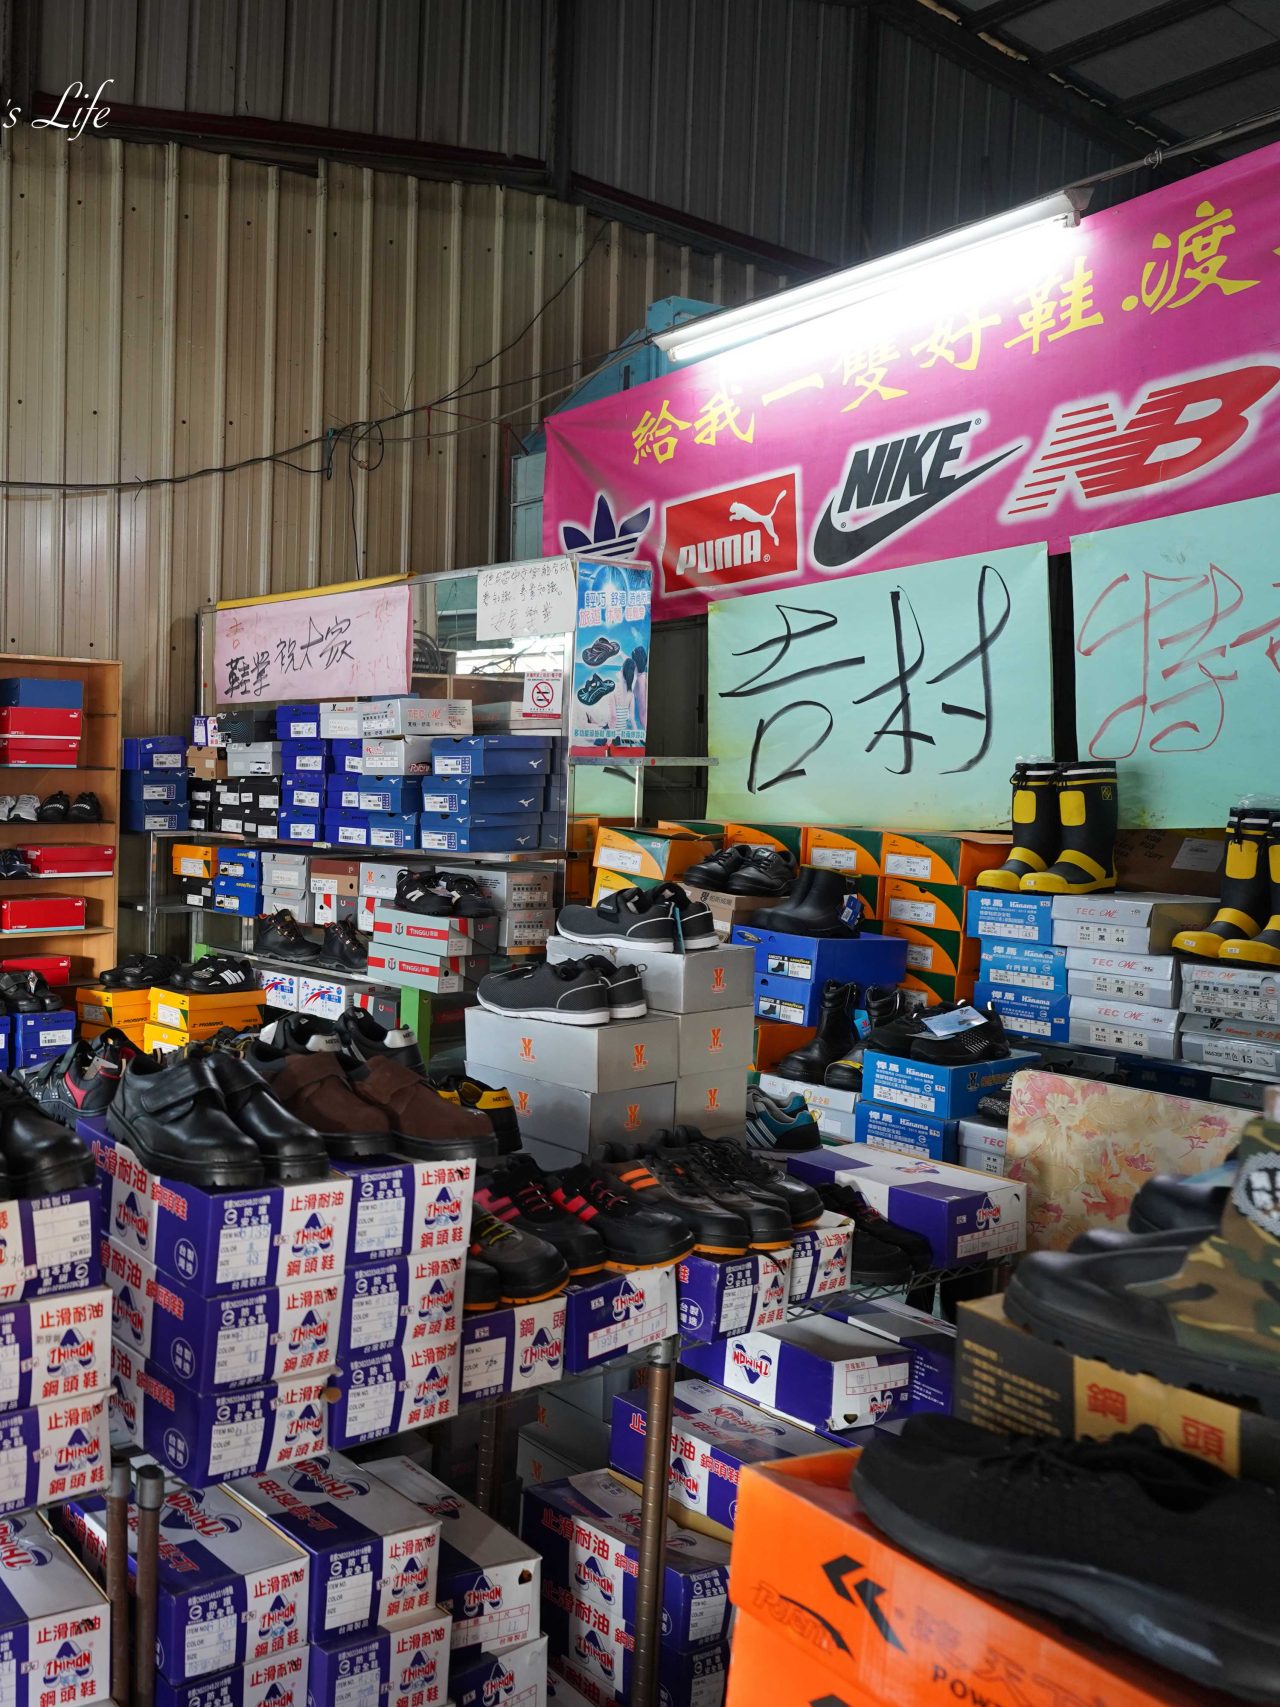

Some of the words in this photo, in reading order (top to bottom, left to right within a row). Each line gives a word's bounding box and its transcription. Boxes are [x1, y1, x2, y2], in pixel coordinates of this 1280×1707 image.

[837, 420, 973, 513] NIKE
[675, 528, 762, 577] PUMA
[1075, 907, 1095, 916] TEC
[1092, 958, 1113, 967] TEC
[1097, 1007, 1119, 1017] TEC
[983, 1136, 1004, 1147] TEC
[91, 1140, 148, 1194] 止滑耐油
[421, 1166, 470, 1186] 止滑耐油
[289, 1192, 344, 1212] 止滑耐油
[296, 1226, 334, 1244] THIMON
[420, 1227, 463, 1249] 鋼頭鞋
[286, 1254, 334, 1277] 鋼頭鞋
[415, 1257, 462, 1280] 止滑耐油
[286, 1287, 338, 1310] 止滑耐油
[39, 1302, 104, 1330] 止滑耐油
[412, 1316, 456, 1339] 鋼頭鞋
[292, 1321, 328, 1343] THIMON
[50, 1341, 94, 1364] THIMON
[283, 1348, 330, 1373] 鋼頭鞋
[411, 1342, 457, 1368] 止滑耐油
[42, 1370, 98, 1399] 鋼頭鞋
[285, 1386, 323, 1405] 止滑
[48, 1402, 103, 1431] 止滑耐油
[407, 1399, 449, 1425] 鋼頭鞋
[289, 1416, 323, 1435] THIMO
[57, 1439, 100, 1463] THIMON
[49, 1466, 105, 1496] 鋼頭鞋
[389, 1534, 436, 1559] 止滑耐油
[254, 1568, 304, 1599] 止滑耐油
[387, 1591, 429, 1617] 鋼頭鞋
[37, 1615, 101, 1644] 止滑耐油
[397, 1627, 445, 1654] 止滑耐油
[255, 1628, 299, 1658] 鋼頭鞋
[40, 1679, 96, 1707] 鋼頭鞋
[396, 1686, 439, 1707] 鋼頭鞋
